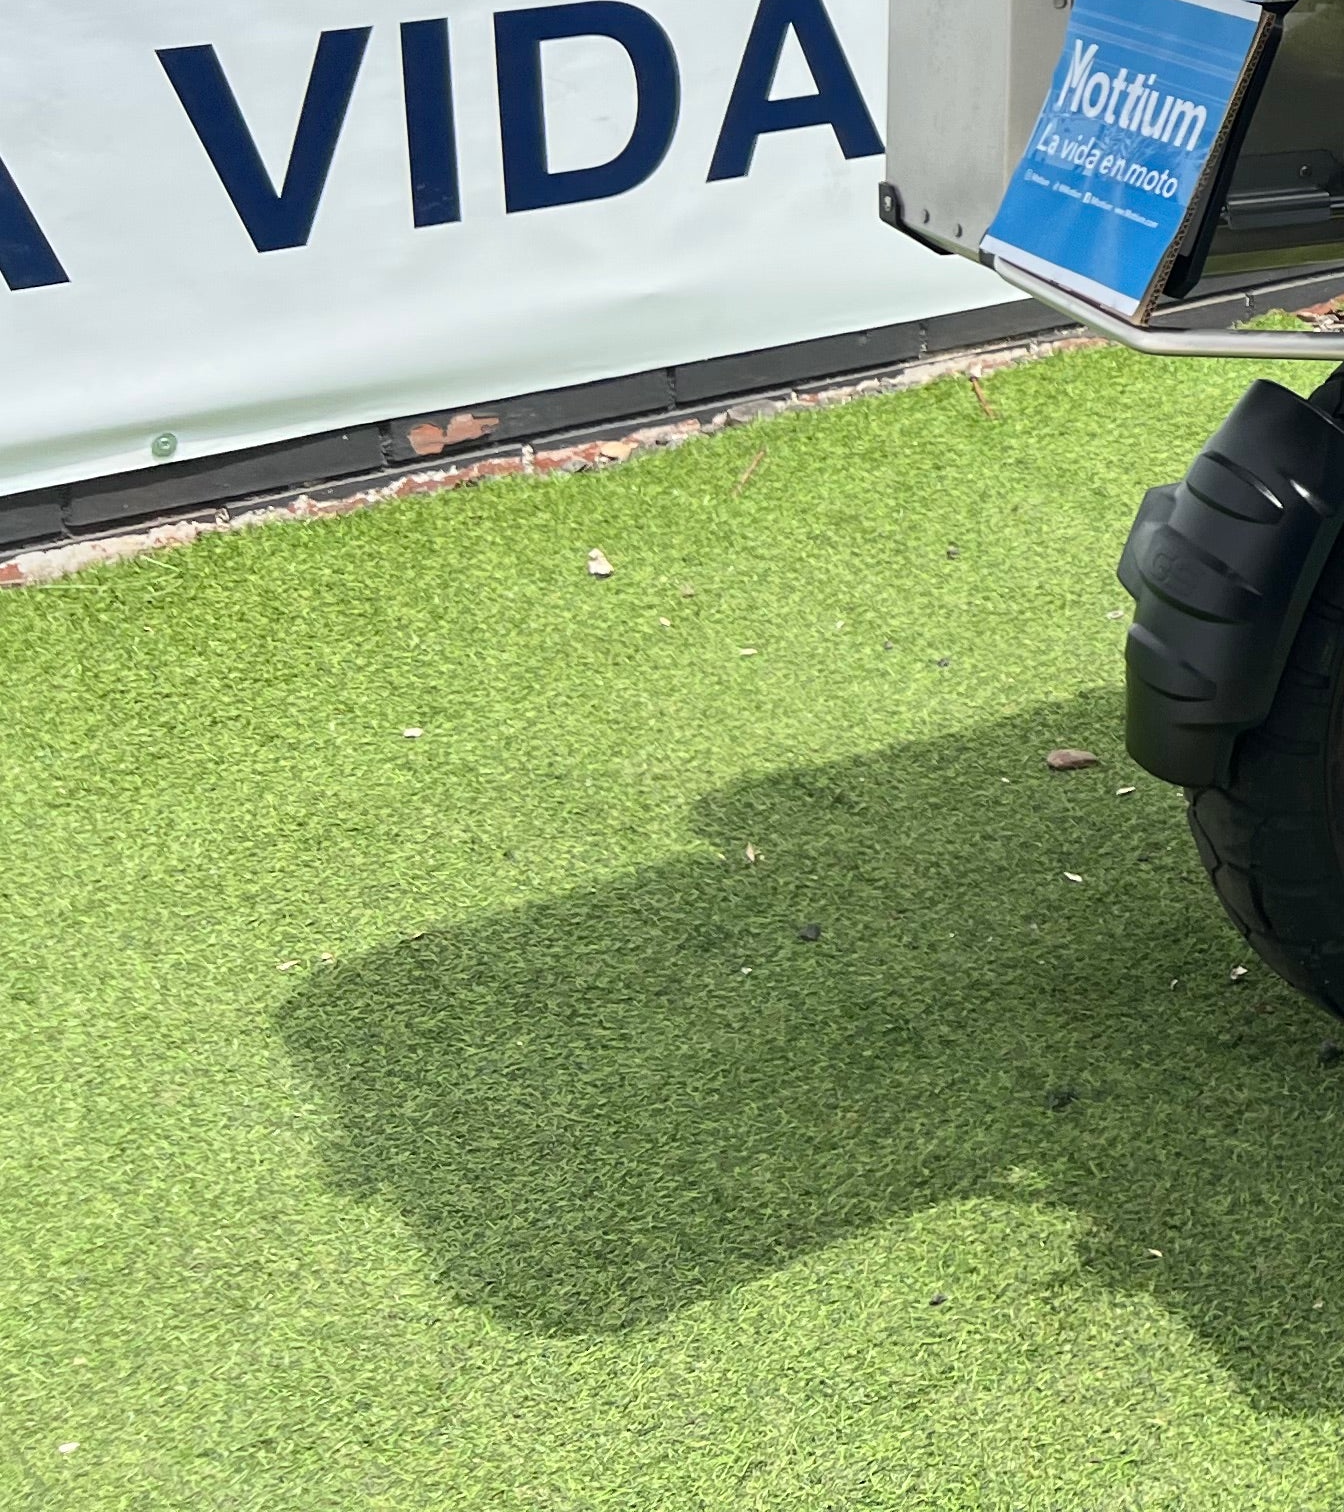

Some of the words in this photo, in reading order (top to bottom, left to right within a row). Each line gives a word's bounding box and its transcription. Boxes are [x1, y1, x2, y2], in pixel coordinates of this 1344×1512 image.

[1036, 123, 1060, 156] La
[1060, 134, 1100, 169] vida
[1123, 162, 1178, 198] moto
